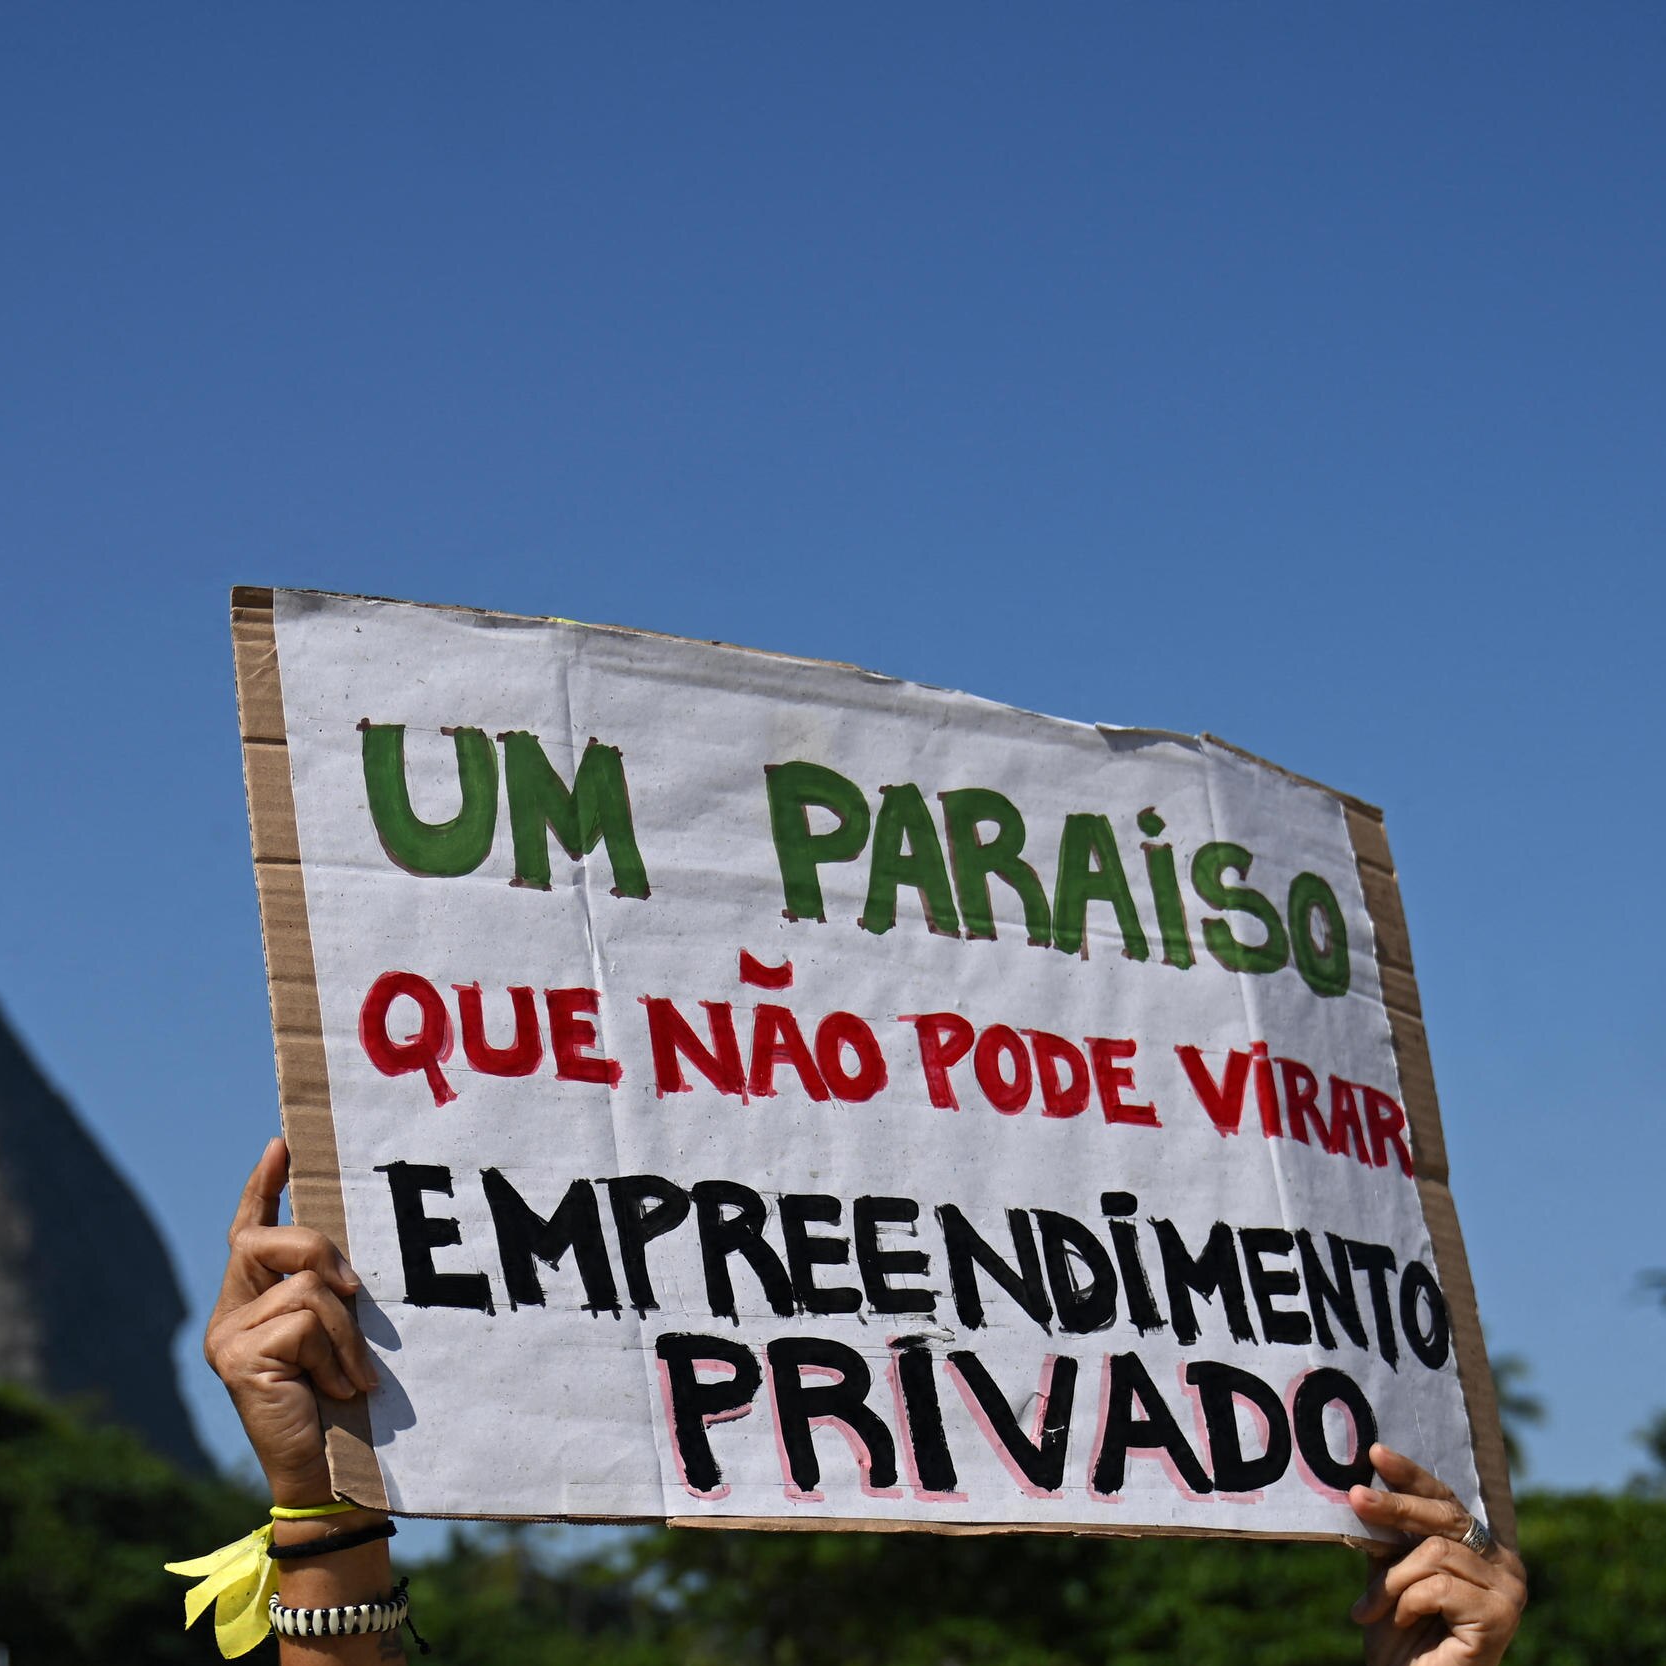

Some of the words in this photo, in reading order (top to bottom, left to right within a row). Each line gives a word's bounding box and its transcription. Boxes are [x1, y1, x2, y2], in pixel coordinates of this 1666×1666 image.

[361, 717, 650, 898] UM
[359, 971, 623, 1108] QUE
[637, 949, 889, 1106] NÃO
[898, 1012, 1163, 1130] PODE
